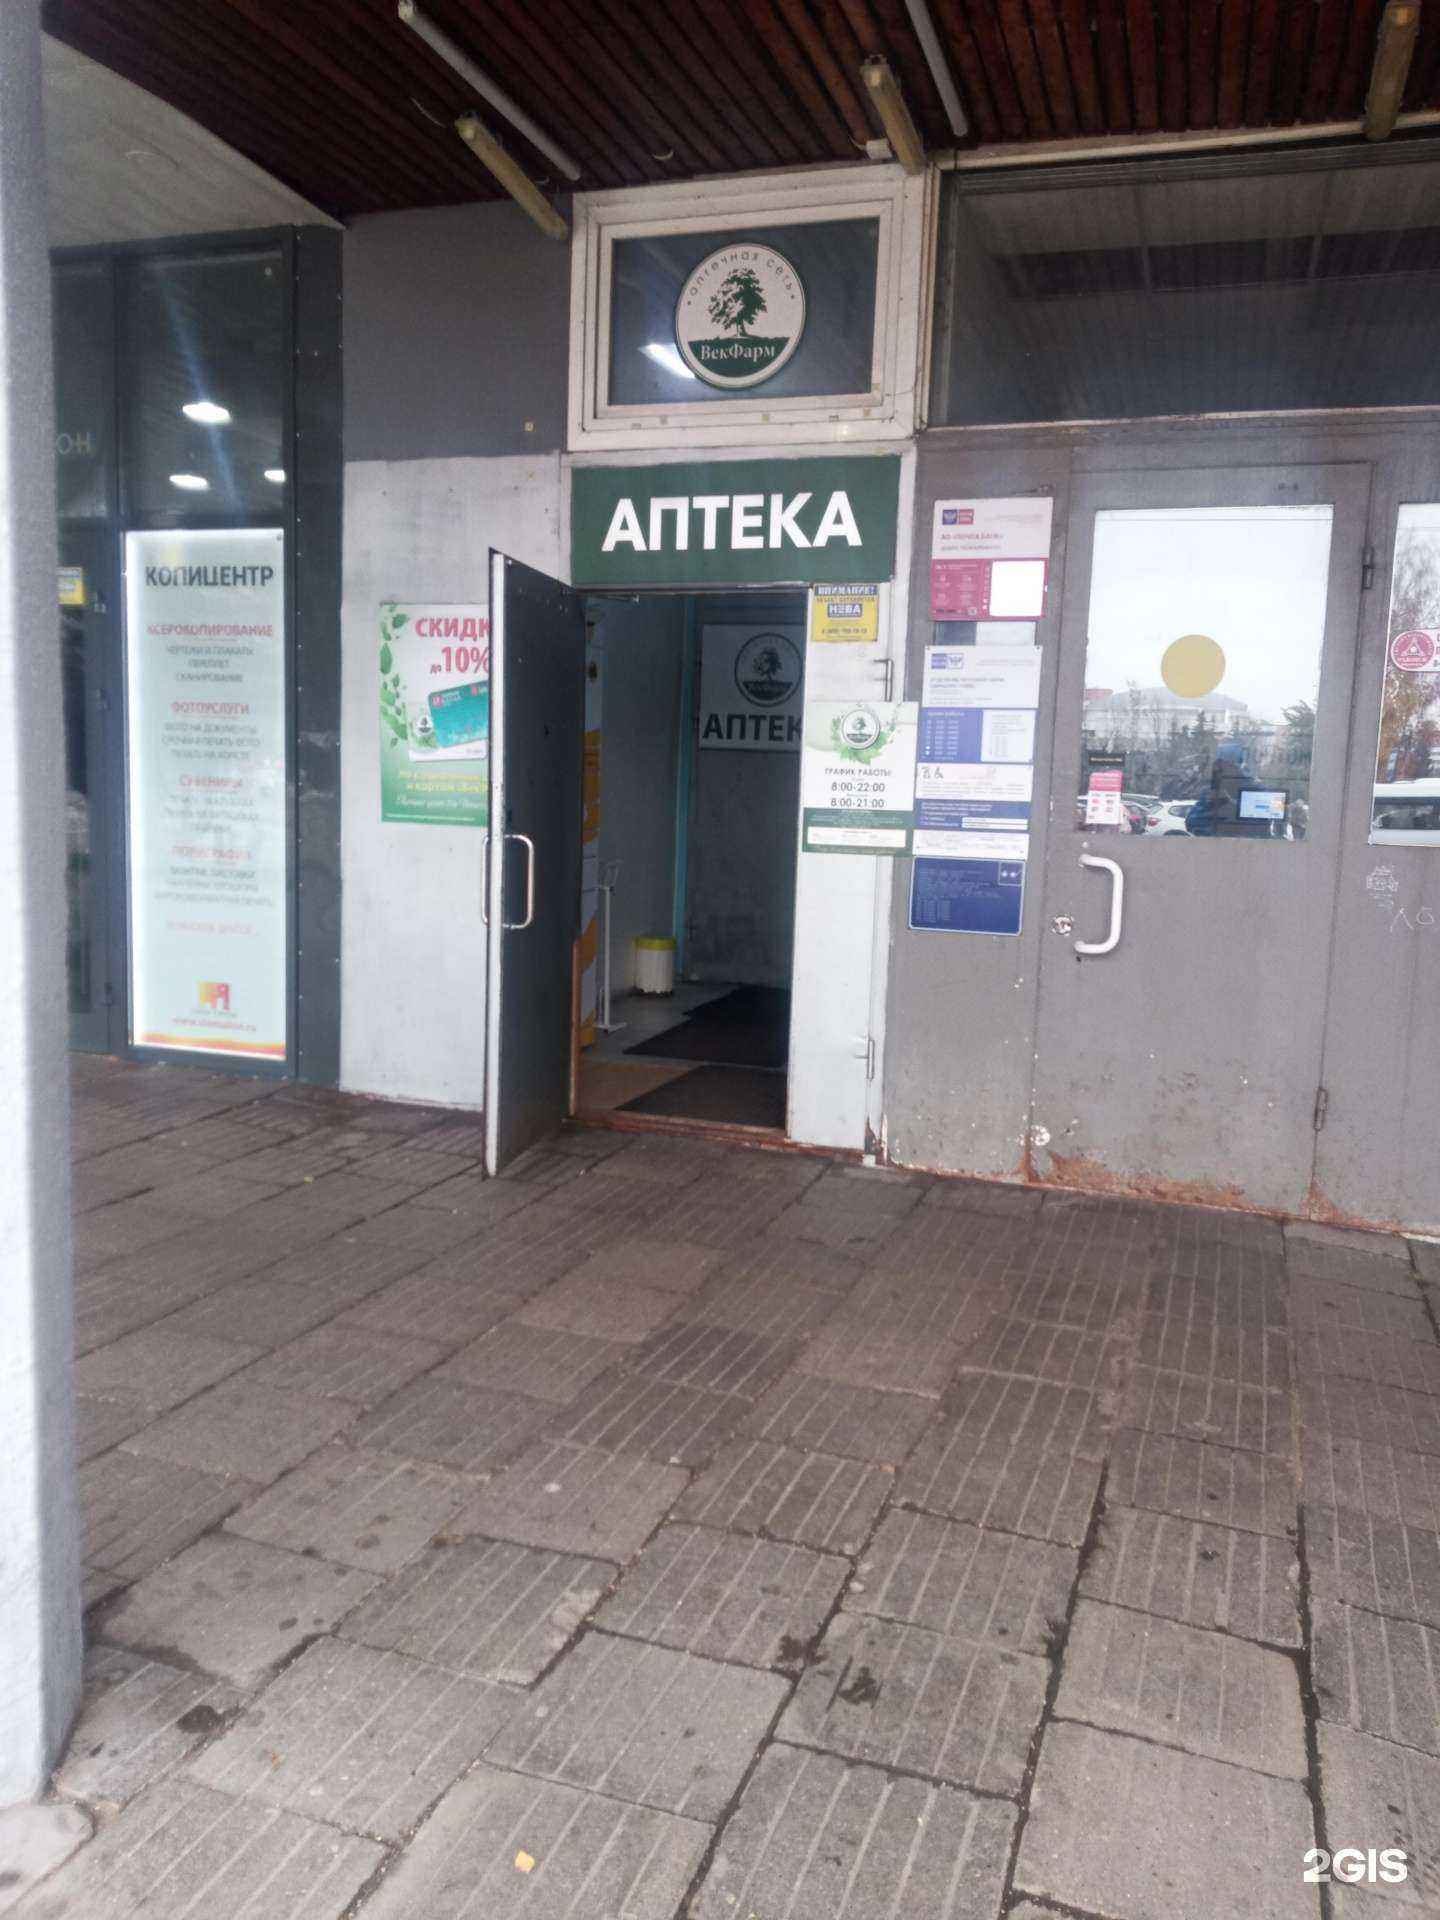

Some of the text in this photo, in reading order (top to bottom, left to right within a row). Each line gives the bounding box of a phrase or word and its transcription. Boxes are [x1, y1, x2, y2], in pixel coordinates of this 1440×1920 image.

[701, 343, 775, 362] ВекФарм
[601, 490, 863, 552] АПТЕКА
[145, 565, 274, 588] КОПИЦЕНТР
[415, 616, 490, 641] СКИДК
[441, 646, 489, 674] 10%
[702, 713, 803, 743] АПТЕК
[825, 767, 856, 776] ГРАФИК
